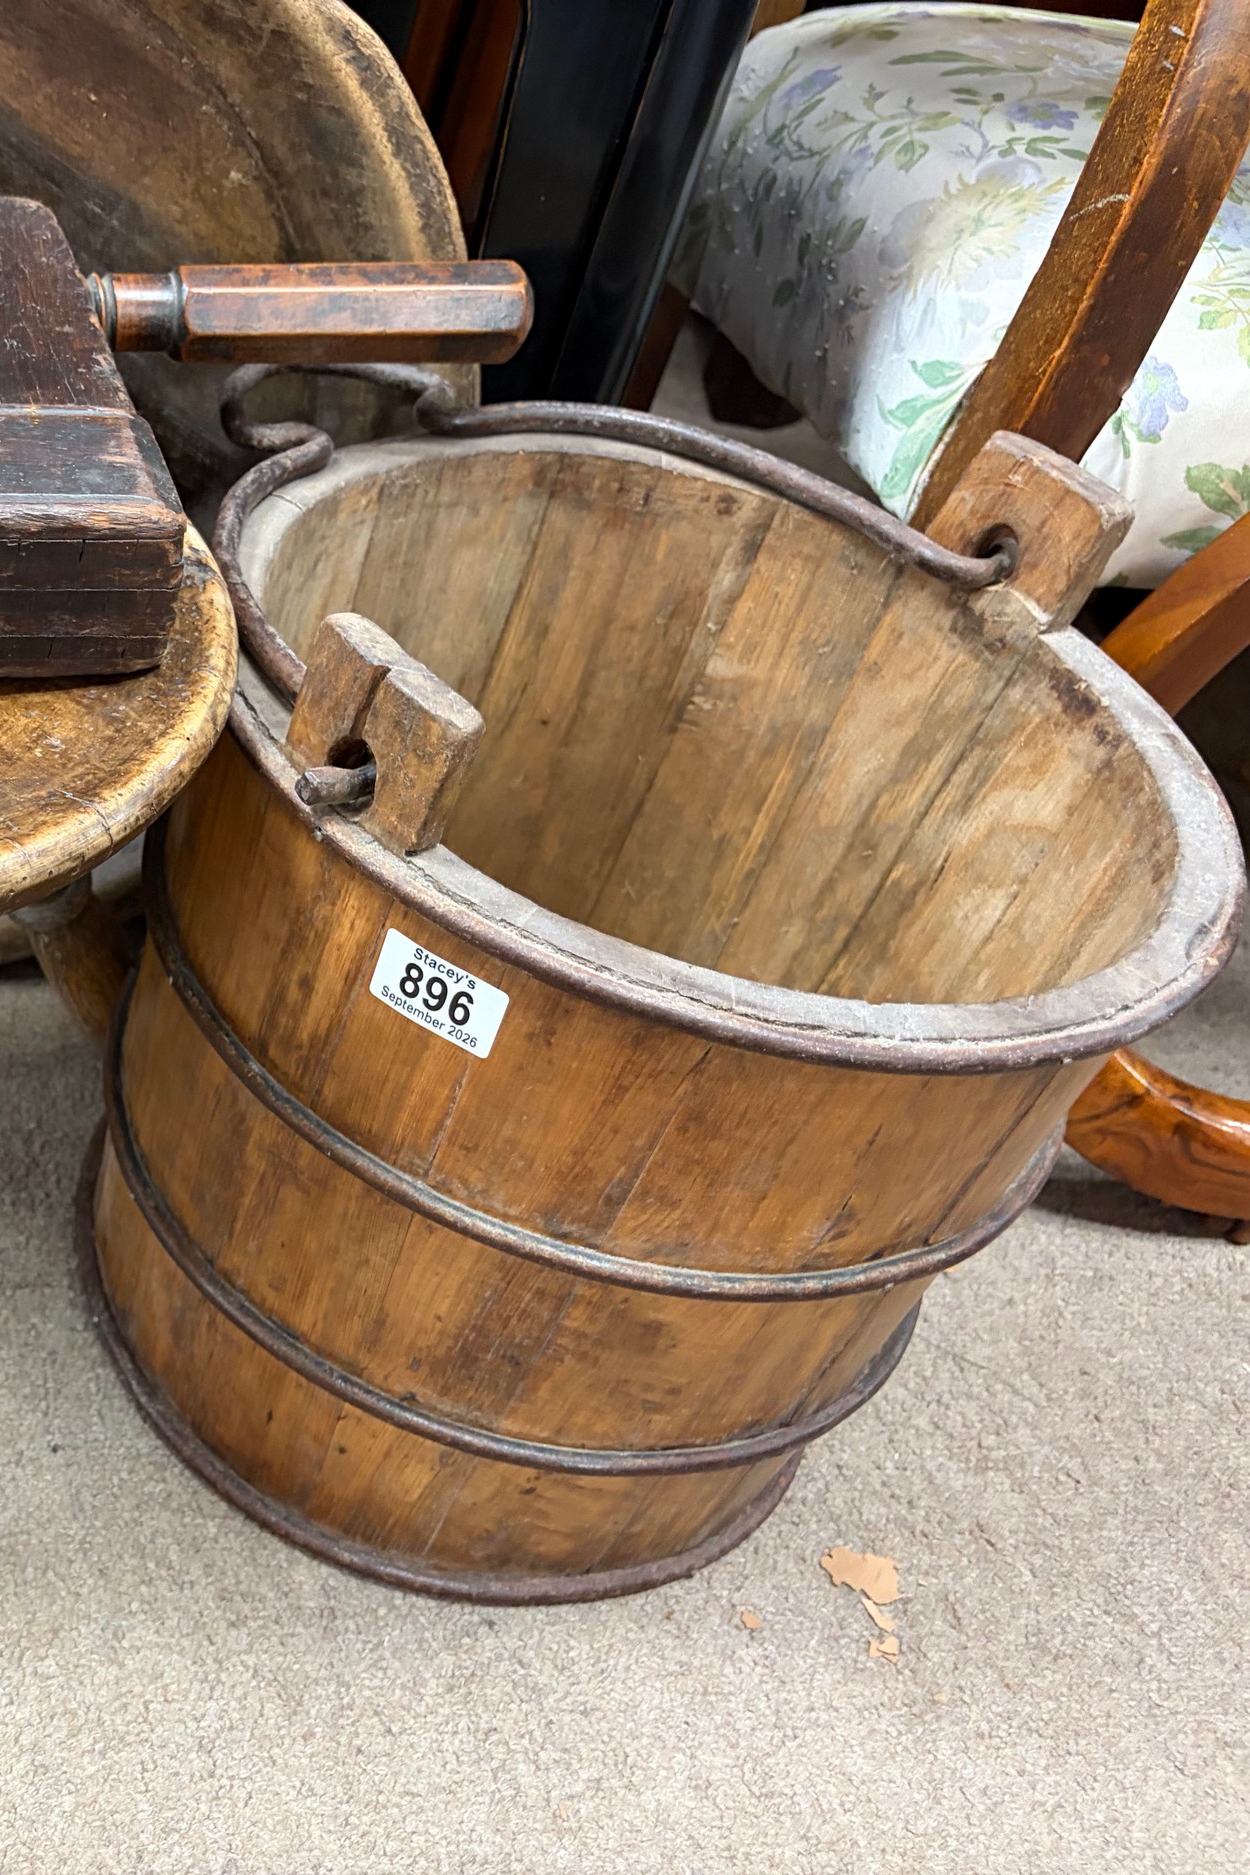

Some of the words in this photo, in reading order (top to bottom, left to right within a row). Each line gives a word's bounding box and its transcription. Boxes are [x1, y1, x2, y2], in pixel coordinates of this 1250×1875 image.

[399, 962, 474, 1026] 896
[413, 947, 477, 990] Stacey's
[381, 985, 446, 1030] September
[447, 1025, 478, 1048] 2026
